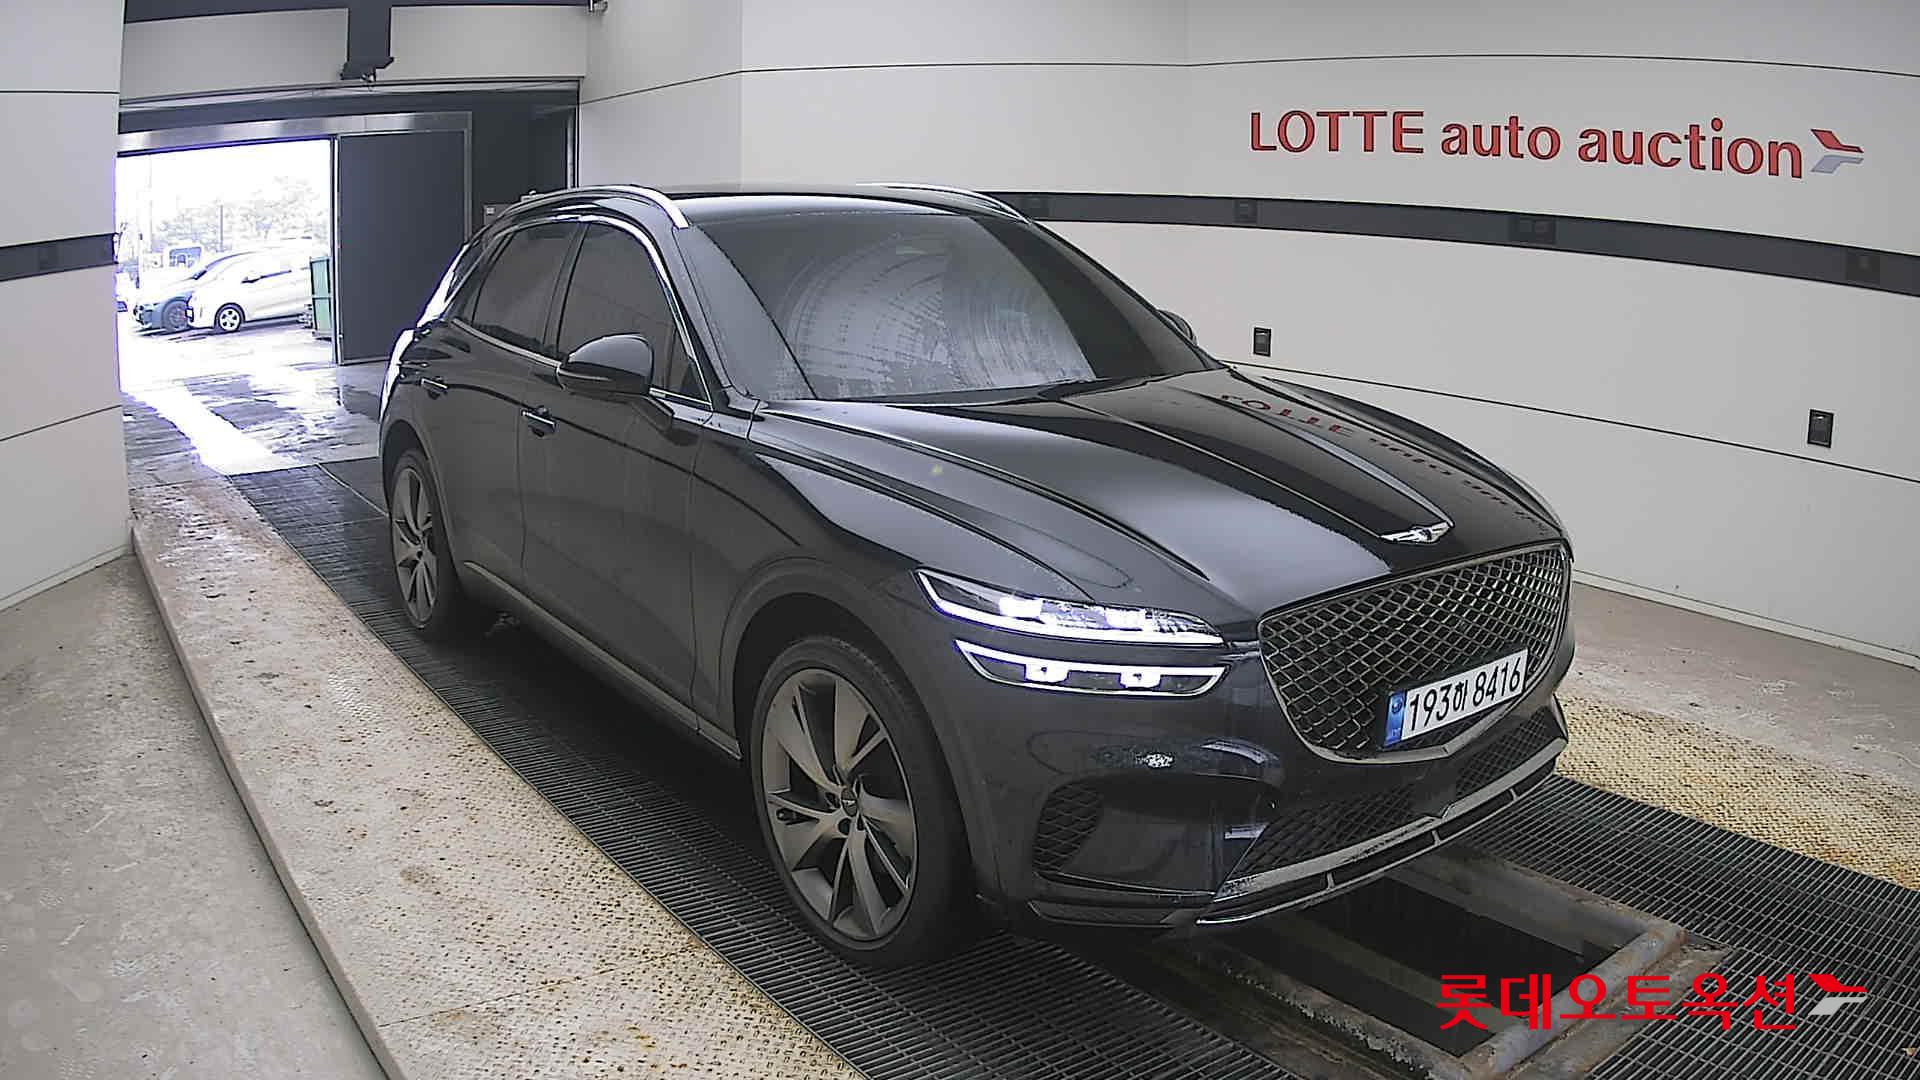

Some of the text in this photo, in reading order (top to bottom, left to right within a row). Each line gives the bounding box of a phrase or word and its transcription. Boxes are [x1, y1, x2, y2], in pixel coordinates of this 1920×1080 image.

[1249, 110, 1803, 179] LOTTE auto auction
[1473, 657, 1522, 707] 8416
